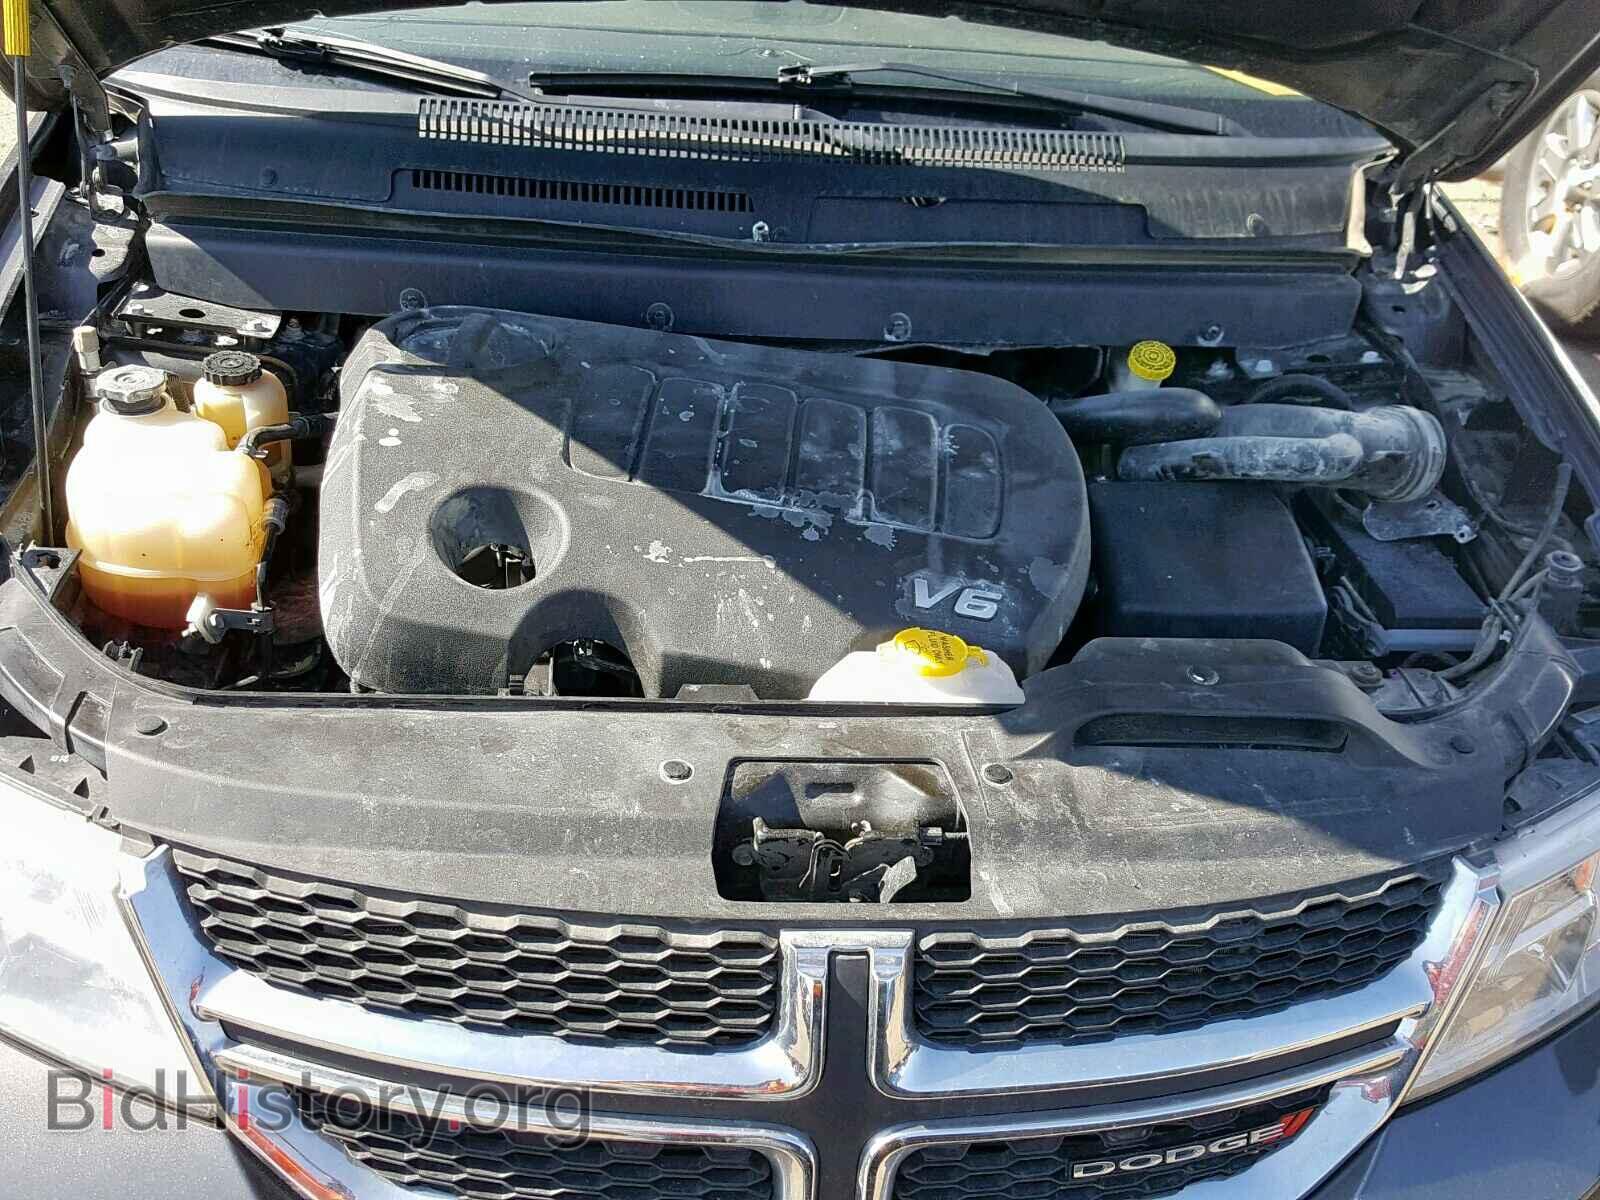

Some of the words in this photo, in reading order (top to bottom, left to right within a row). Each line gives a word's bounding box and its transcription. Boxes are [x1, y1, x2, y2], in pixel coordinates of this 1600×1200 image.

[914, 578, 1003, 620] V6
[927, 631, 939, 649] FLUID
[940, 635, 954, 661] WASHER
[1073, 1122, 1286, 1179] DODGE
